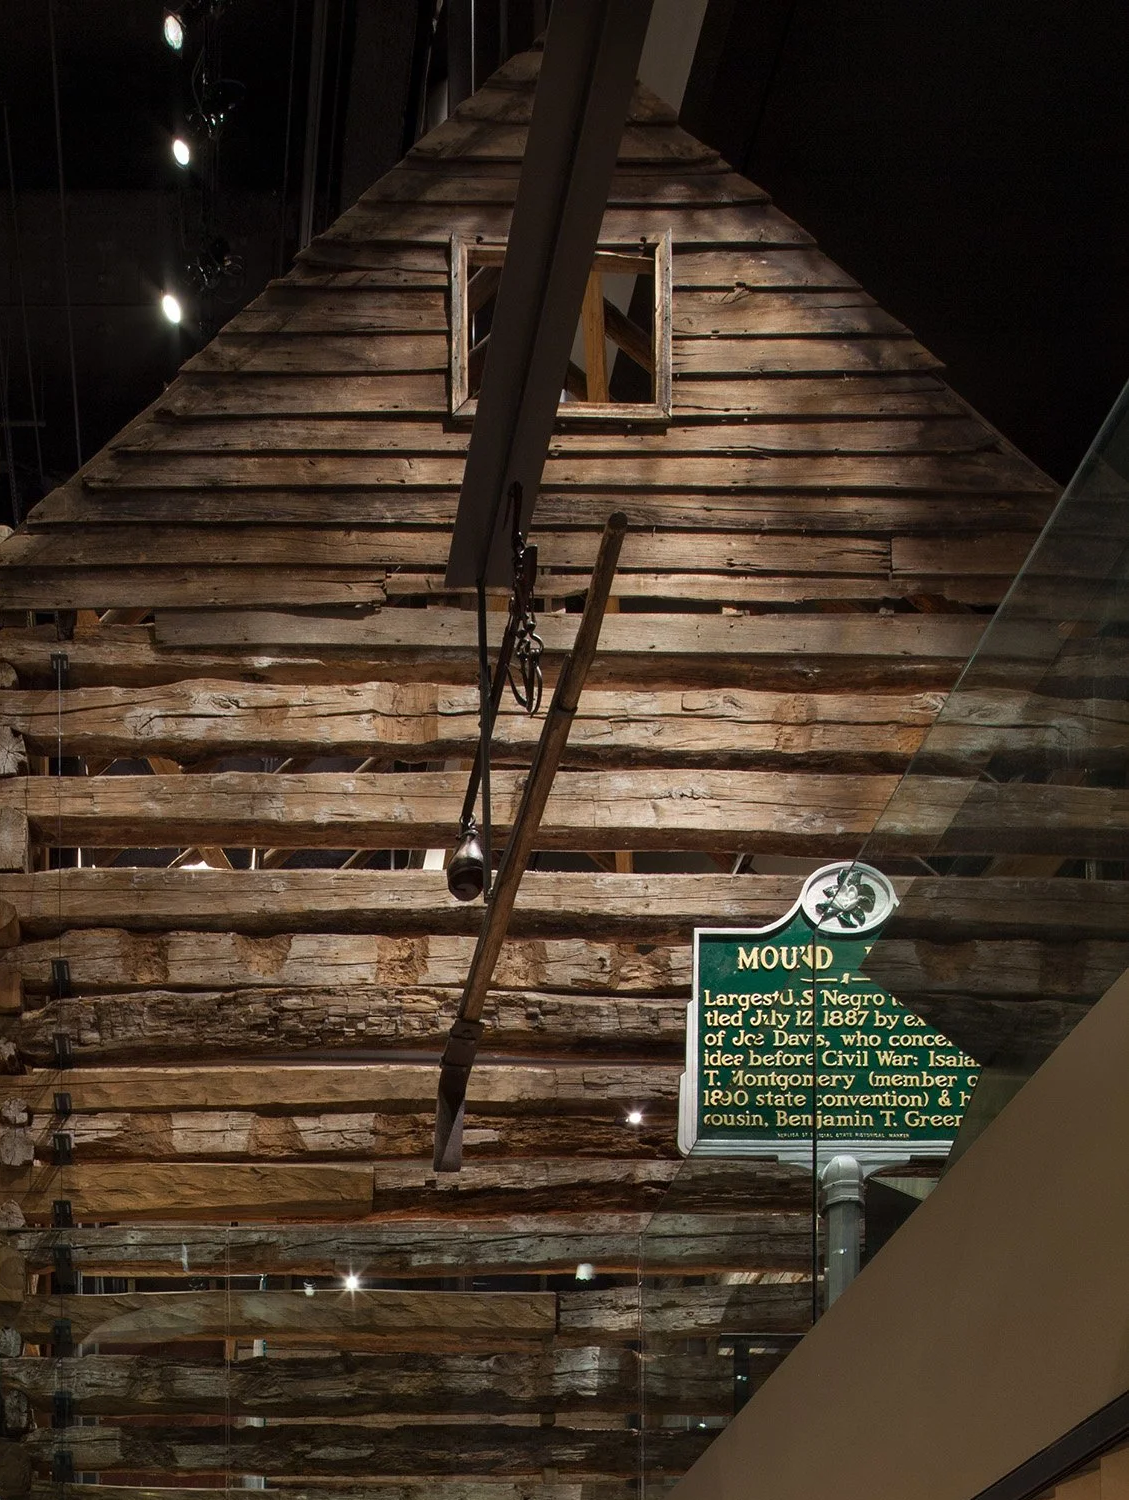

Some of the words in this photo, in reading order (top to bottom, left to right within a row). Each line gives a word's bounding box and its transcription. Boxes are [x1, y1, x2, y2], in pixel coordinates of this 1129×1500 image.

[737, 944, 833, 970] MOUND
[704, 989, 779, 1012] Largest
[820, 990, 885, 1011] Negro
[704, 1010, 743, 1026] tled
[822, 1010, 870, 1027] 1887
[873, 1010, 900, 1030] by
[704, 1030, 726, 1046] of
[773, 1030, 831, 1049] Davs,
[841, 1031, 881, 1046] who
[704, 1049, 744, 1066] idea
[748, 1050, 814, 1066] before
[821, 1050, 869, 1067] Civil
[875, 1050, 919, 1067] War:
[929, 1050, 983, 1067] Isaia
[704, 1070, 721, 1086] T.
[730, 1070, 856, 1091] Montgomery
[868, 1071, 958, 1087] (member
[755, 1090, 807, 1107] state
[816, 1090, 929, 1107] convention)
[937, 1089, 952, 1107] &
[704, 1110, 769, 1128] cousin,
[775, 1110, 874, 1129] Benjamin
[880, 1111, 898, 1127] T.
